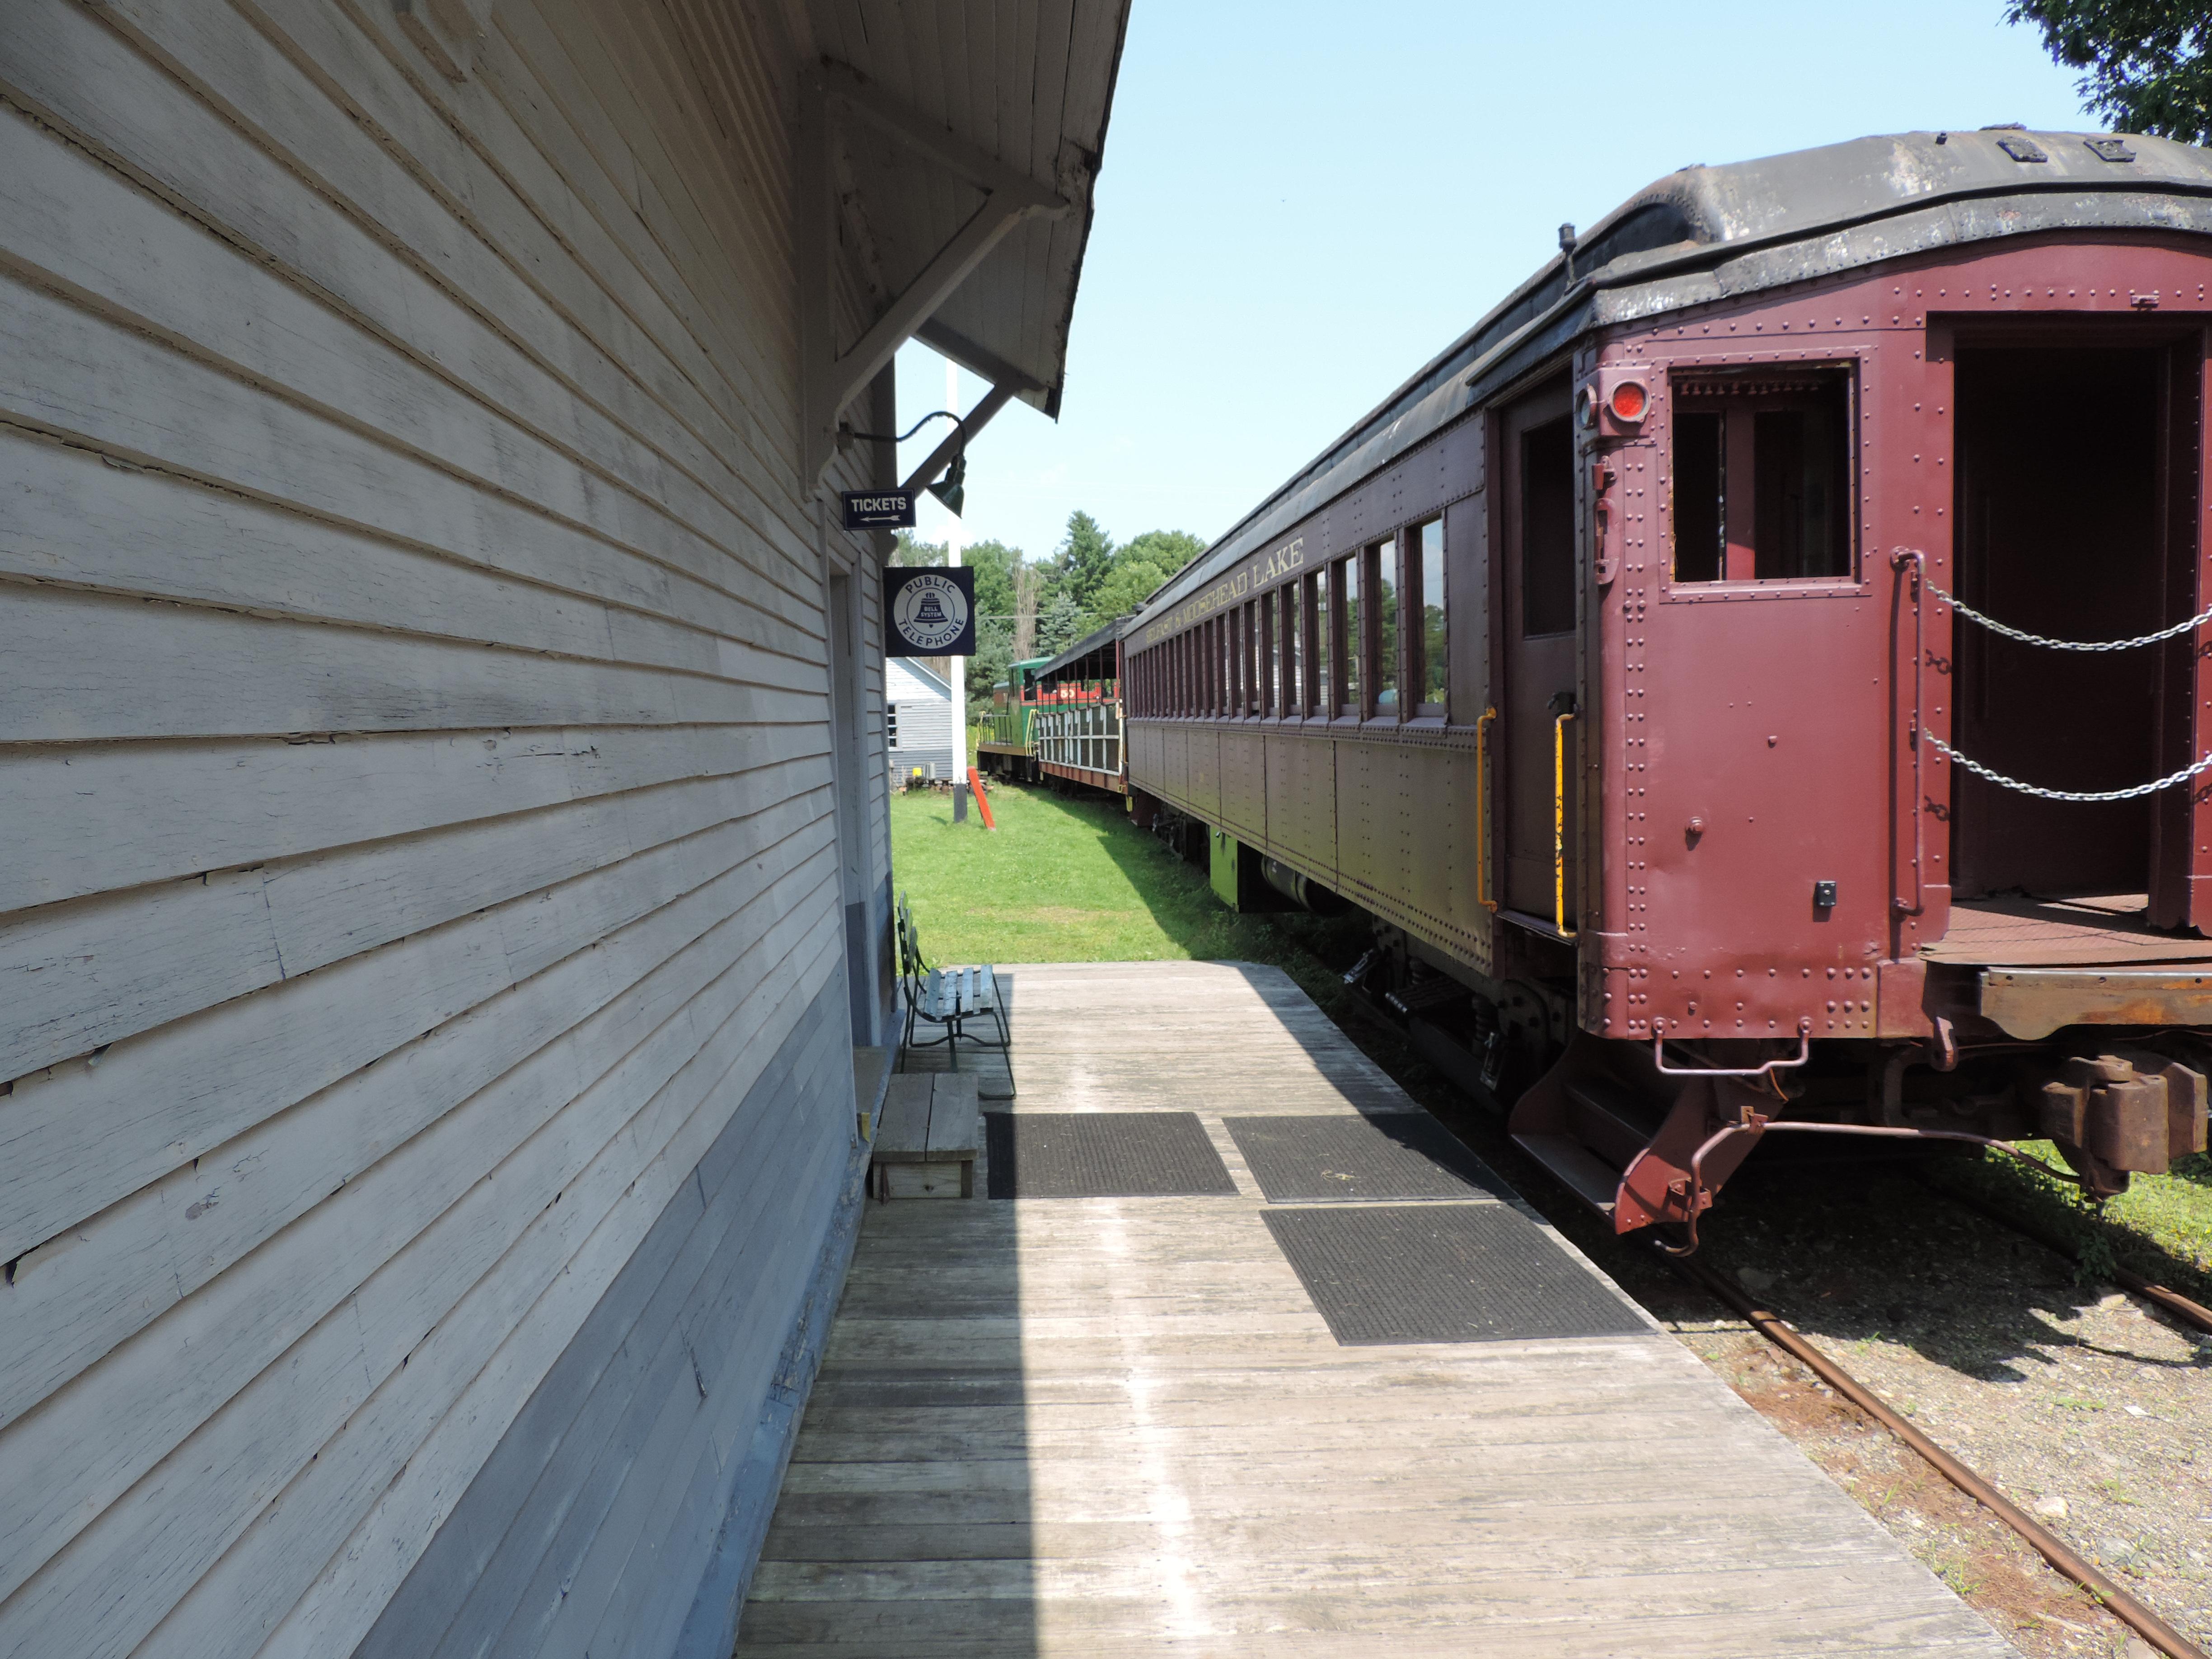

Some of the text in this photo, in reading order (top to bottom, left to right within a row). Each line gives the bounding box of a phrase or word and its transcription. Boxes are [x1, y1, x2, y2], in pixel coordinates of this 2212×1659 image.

[851, 497, 906, 512] TICKETS
[905, 576, 956, 593] PUBLIC
[1183, 572, 1247, 625] MOOSEHEAD
[1253, 538, 1304, 588] LAKE
[899, 618, 964, 646] TELEPHONE
[1060, 689, 1075, 698] 50
